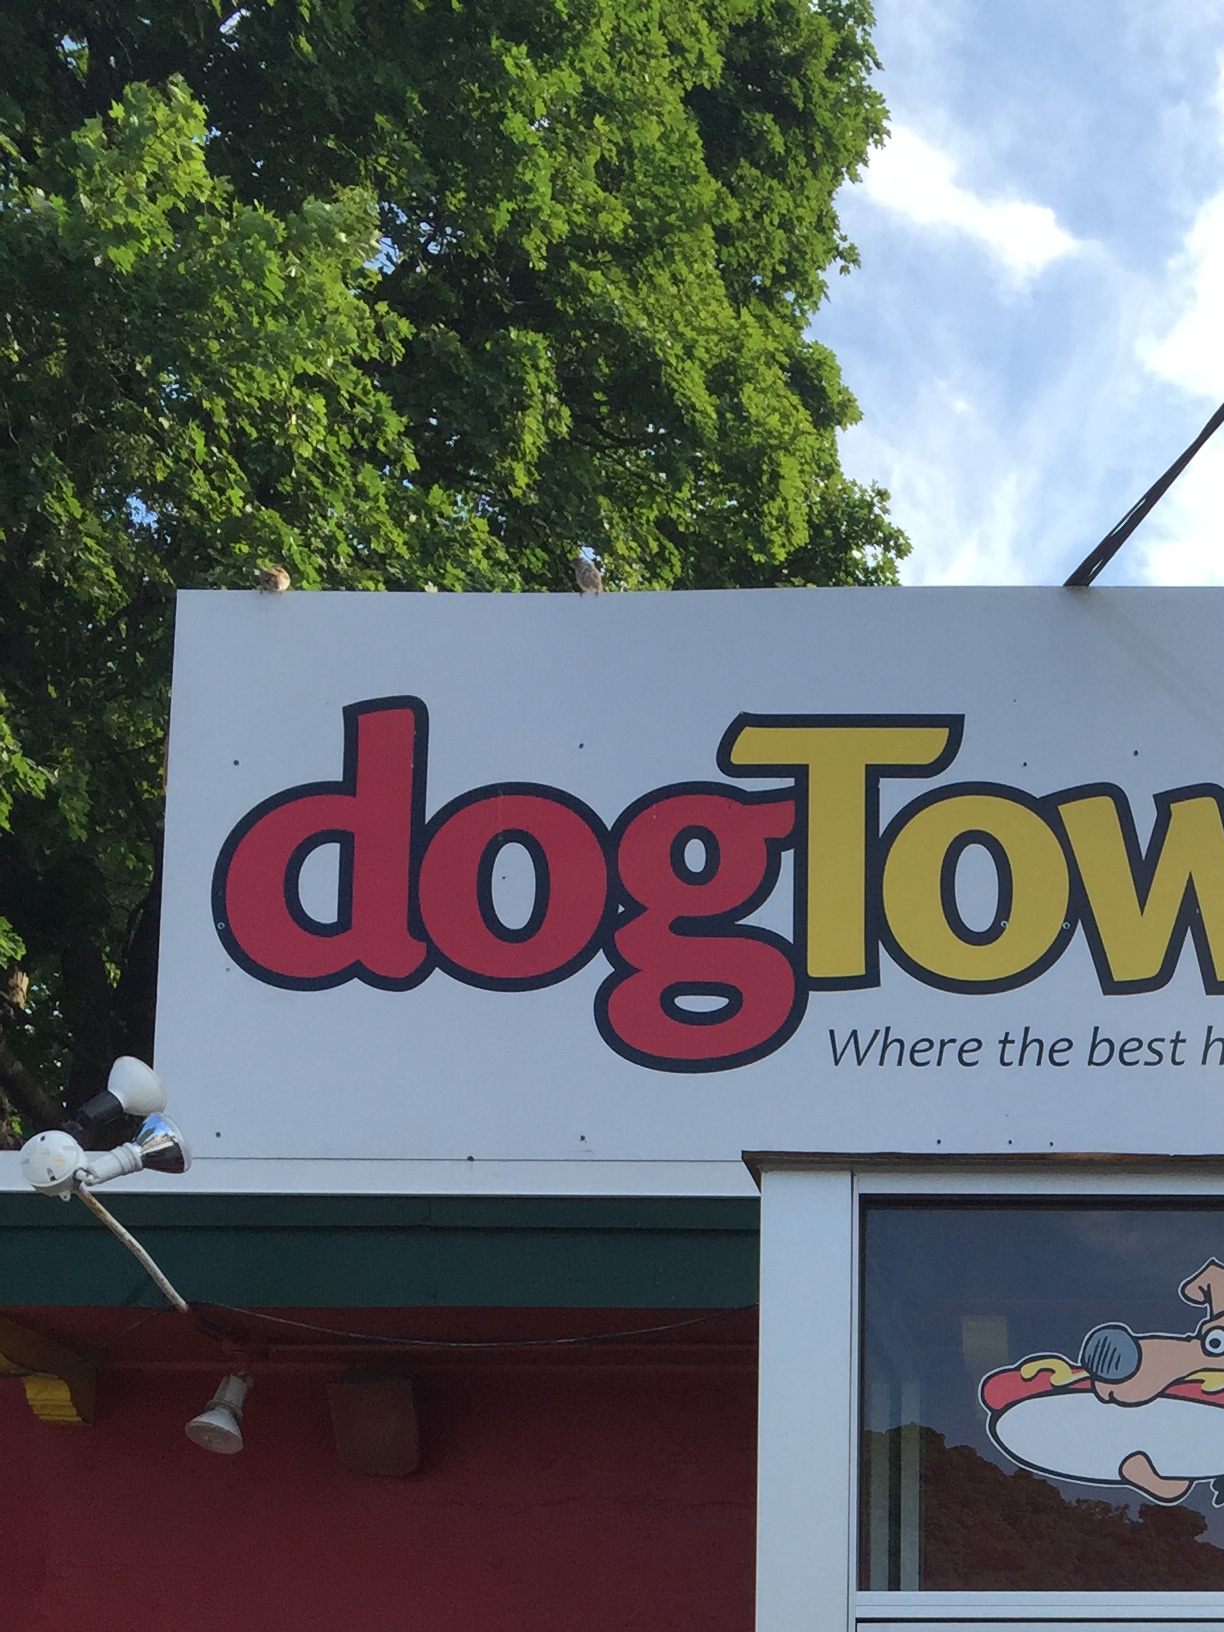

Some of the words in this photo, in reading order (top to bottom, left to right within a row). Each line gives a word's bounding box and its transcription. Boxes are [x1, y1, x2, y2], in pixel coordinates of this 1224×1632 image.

[827, 1027, 984, 1068] Where
[997, 1025, 1074, 1068] the
[1086, 1024, 1187, 1067] best
